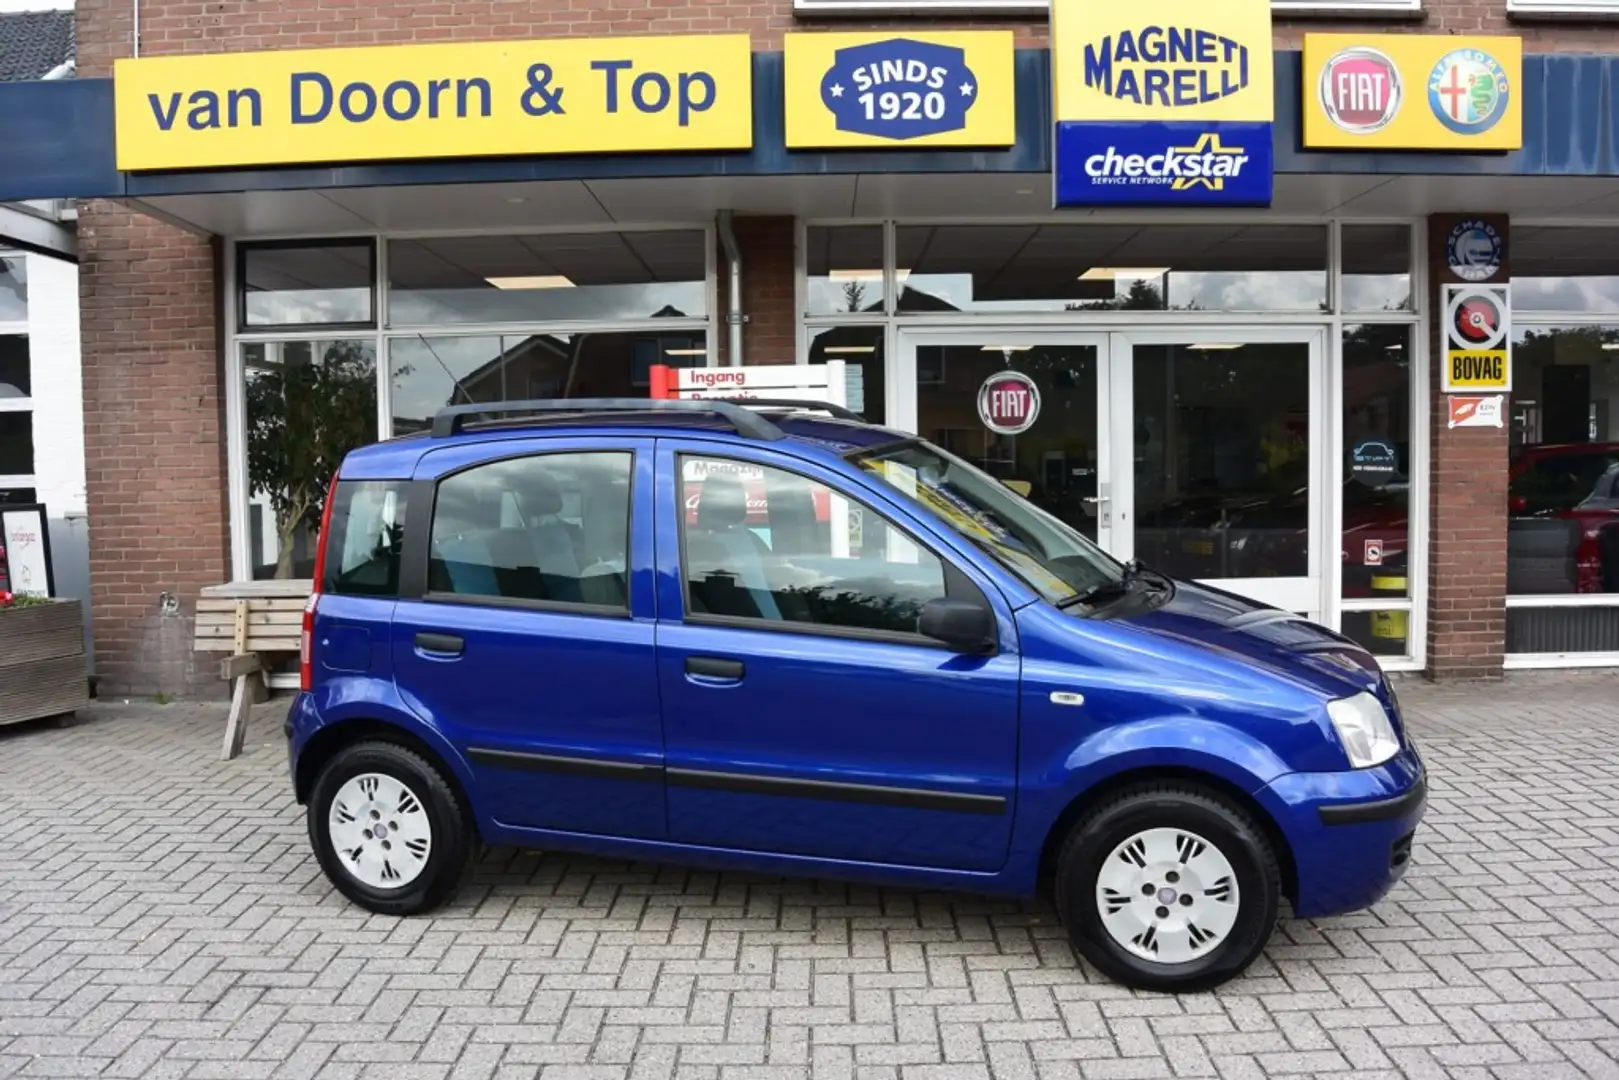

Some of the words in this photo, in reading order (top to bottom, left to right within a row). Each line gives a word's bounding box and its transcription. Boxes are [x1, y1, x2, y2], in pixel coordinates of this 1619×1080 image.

[1084, 25, 1248, 84] MAGNETI
[852, 59, 948, 91] SINDS
[1084, 50, 1248, 107] MARELLI
[148, 84, 262, 131] van
[290, 71, 492, 125] Doorn
[520, 62, 566, 117] &
[590, 59, 717, 127] Top
[858, 91, 945, 120] 1920
[1338, 73, 1385, 111] FIAT
[1084, 146, 1249, 177] checkstar
[1092, 177, 1127, 185] SERVICE
[1129, 177, 1174, 185] NETWORK
[691, 370, 745, 386] Ingang
[1453, 356, 1502, 380] BOVAG
[993, 390, 1027, 418] FIAT
